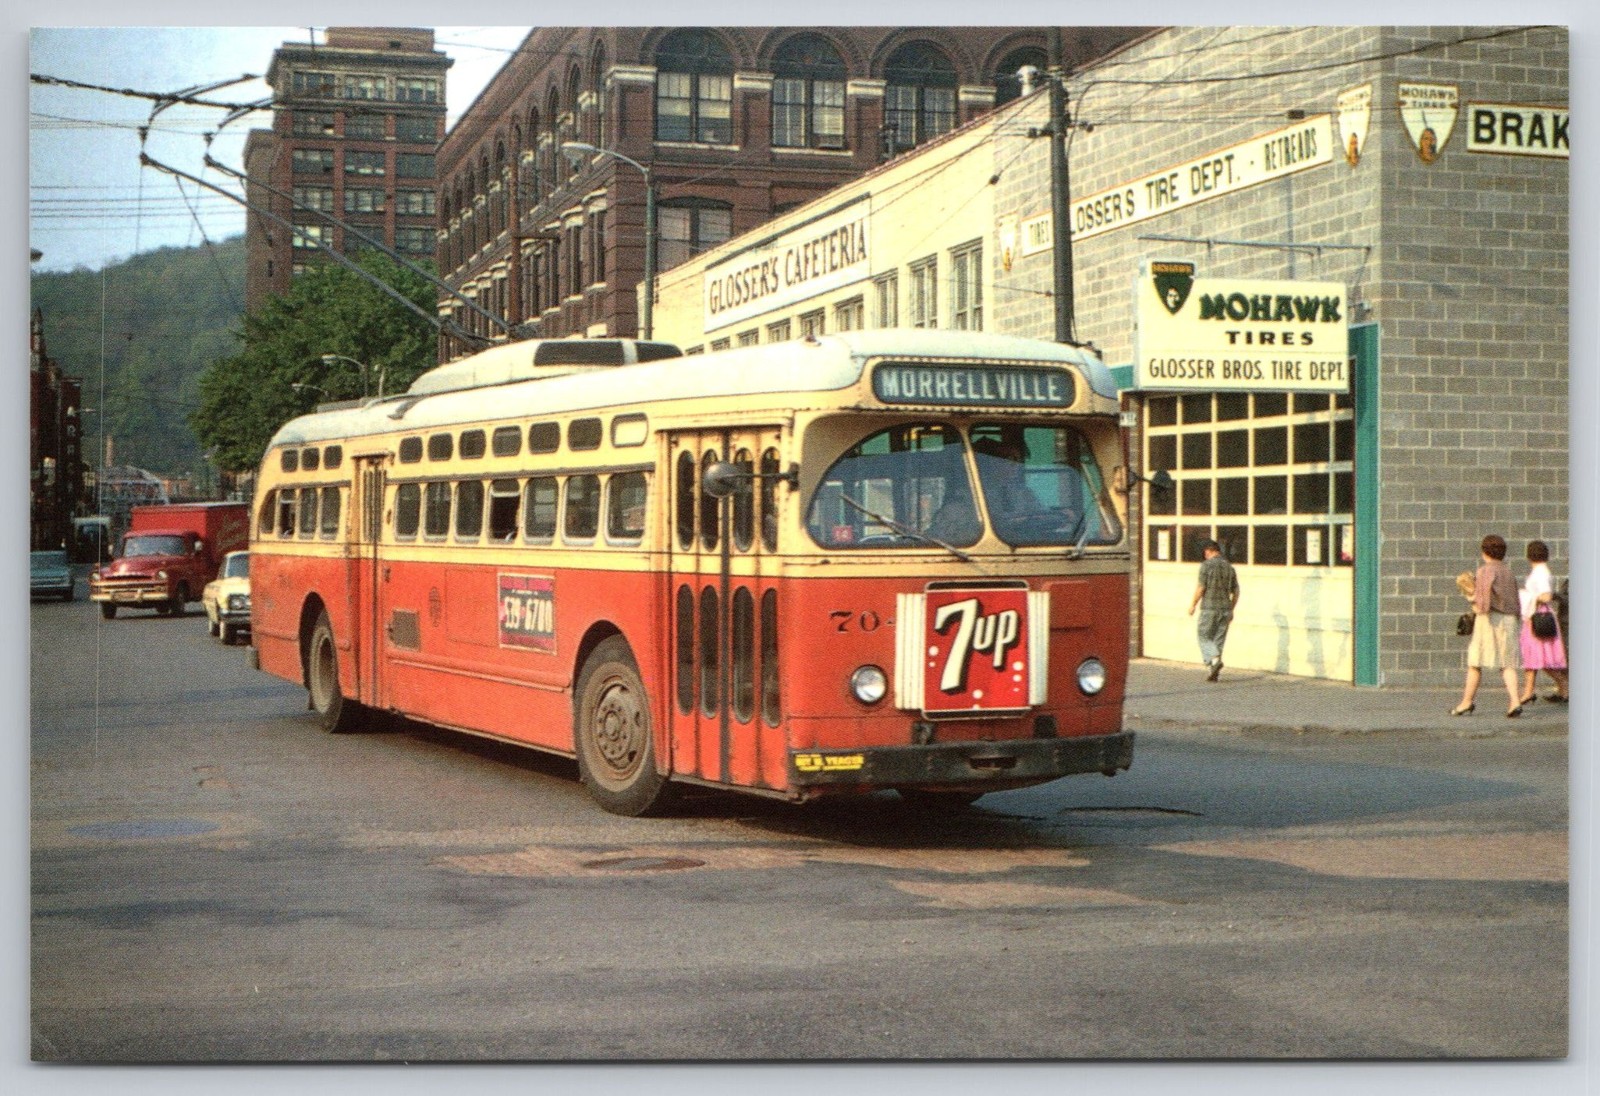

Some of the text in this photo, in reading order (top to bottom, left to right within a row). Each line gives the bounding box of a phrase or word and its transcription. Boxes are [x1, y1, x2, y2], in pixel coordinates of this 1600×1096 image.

[1474, 109, 1569, 149] BRAK
[1145, 175, 1180, 213] TIRE
[1190, 153, 1241, 196] DEPT.
[709, 217, 867, 315] GLOSSER'S CAFETERIA
[1200, 292, 1342, 323] MOHAWK
[1226, 331, 1314, 345] TIRES
[880, 368, 1062, 402] MORRELLVILLE
[1149, 357, 1346, 382] GLOSSER BROS. TIRE DEPT.
[829, 608, 896, 633] 70
